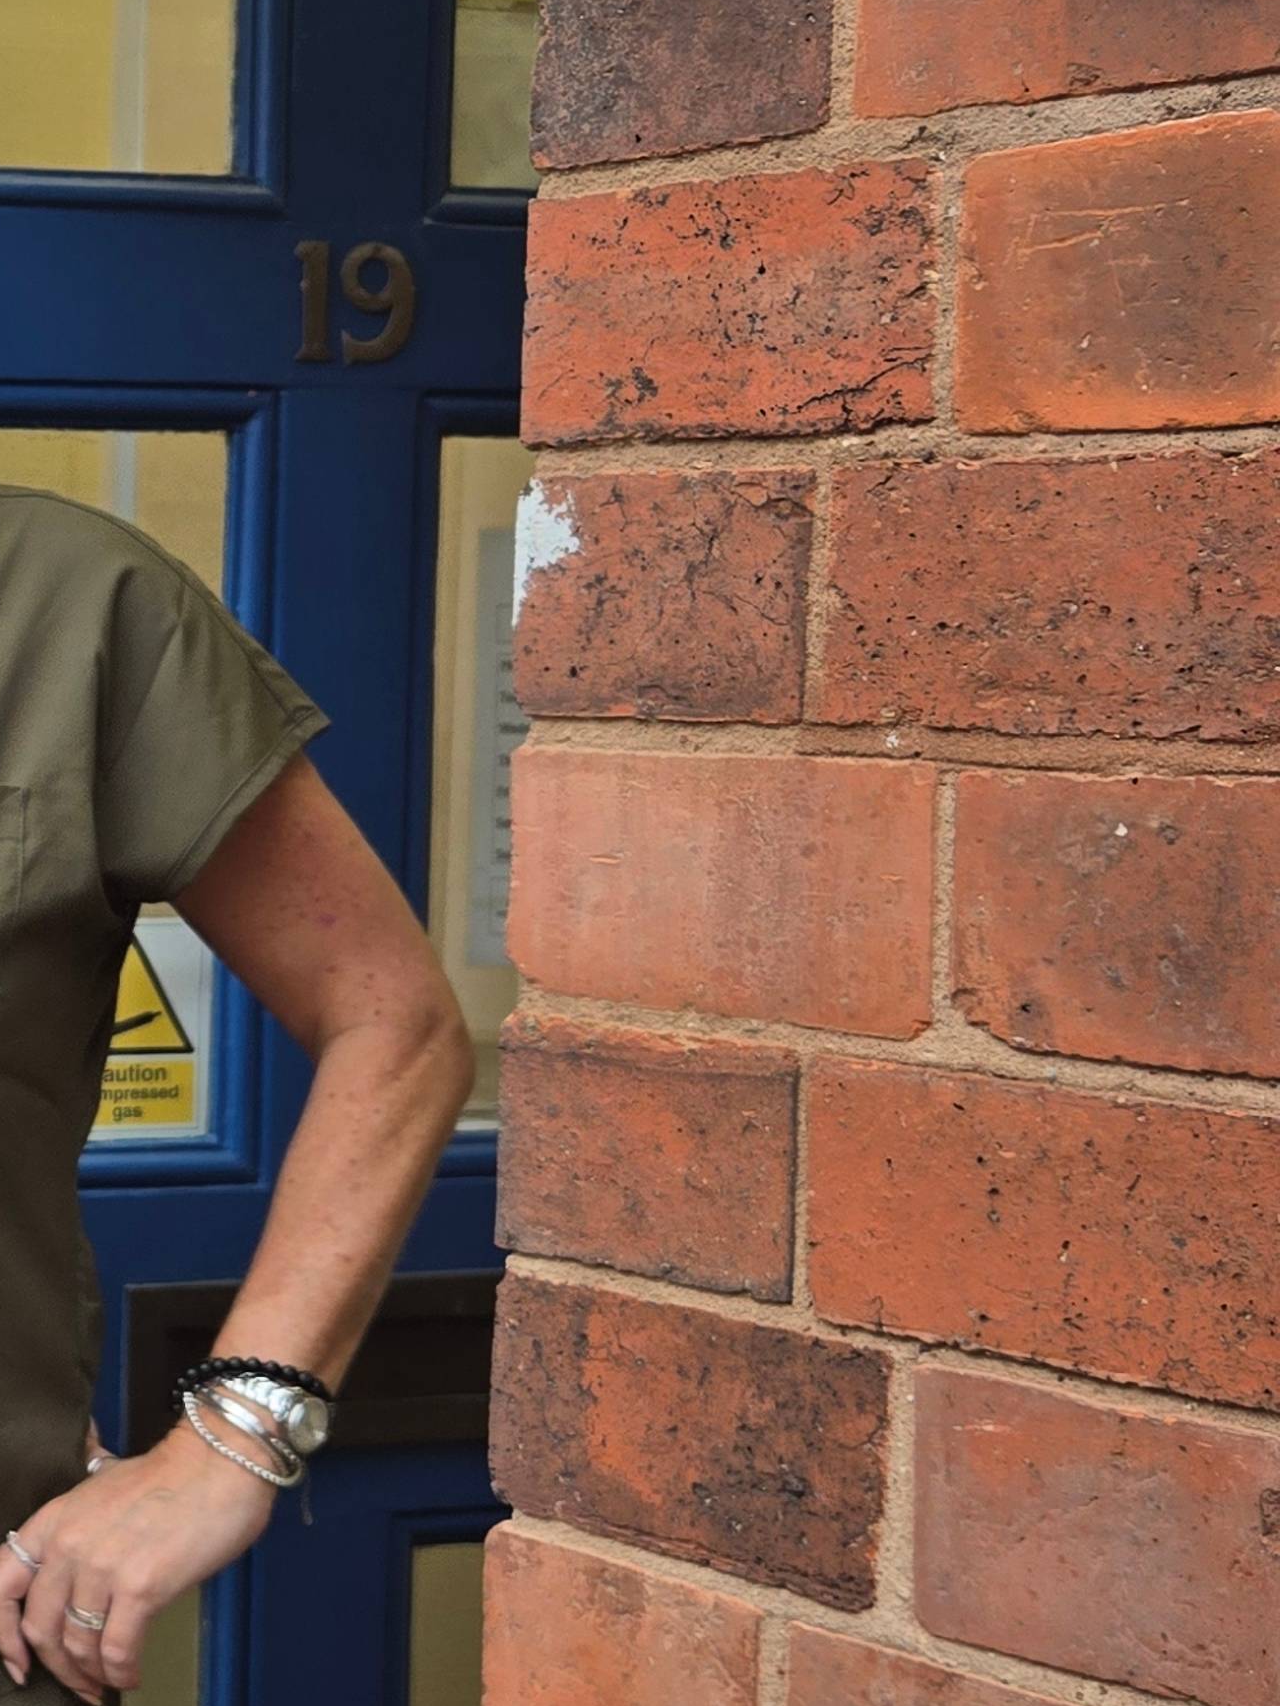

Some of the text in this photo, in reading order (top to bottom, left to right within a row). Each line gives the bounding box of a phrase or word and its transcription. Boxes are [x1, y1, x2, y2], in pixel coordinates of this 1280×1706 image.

[294, 239, 416, 365] 19
[102, 1064, 167, 1083] aution
[112, 1106, 143, 1122] gas
